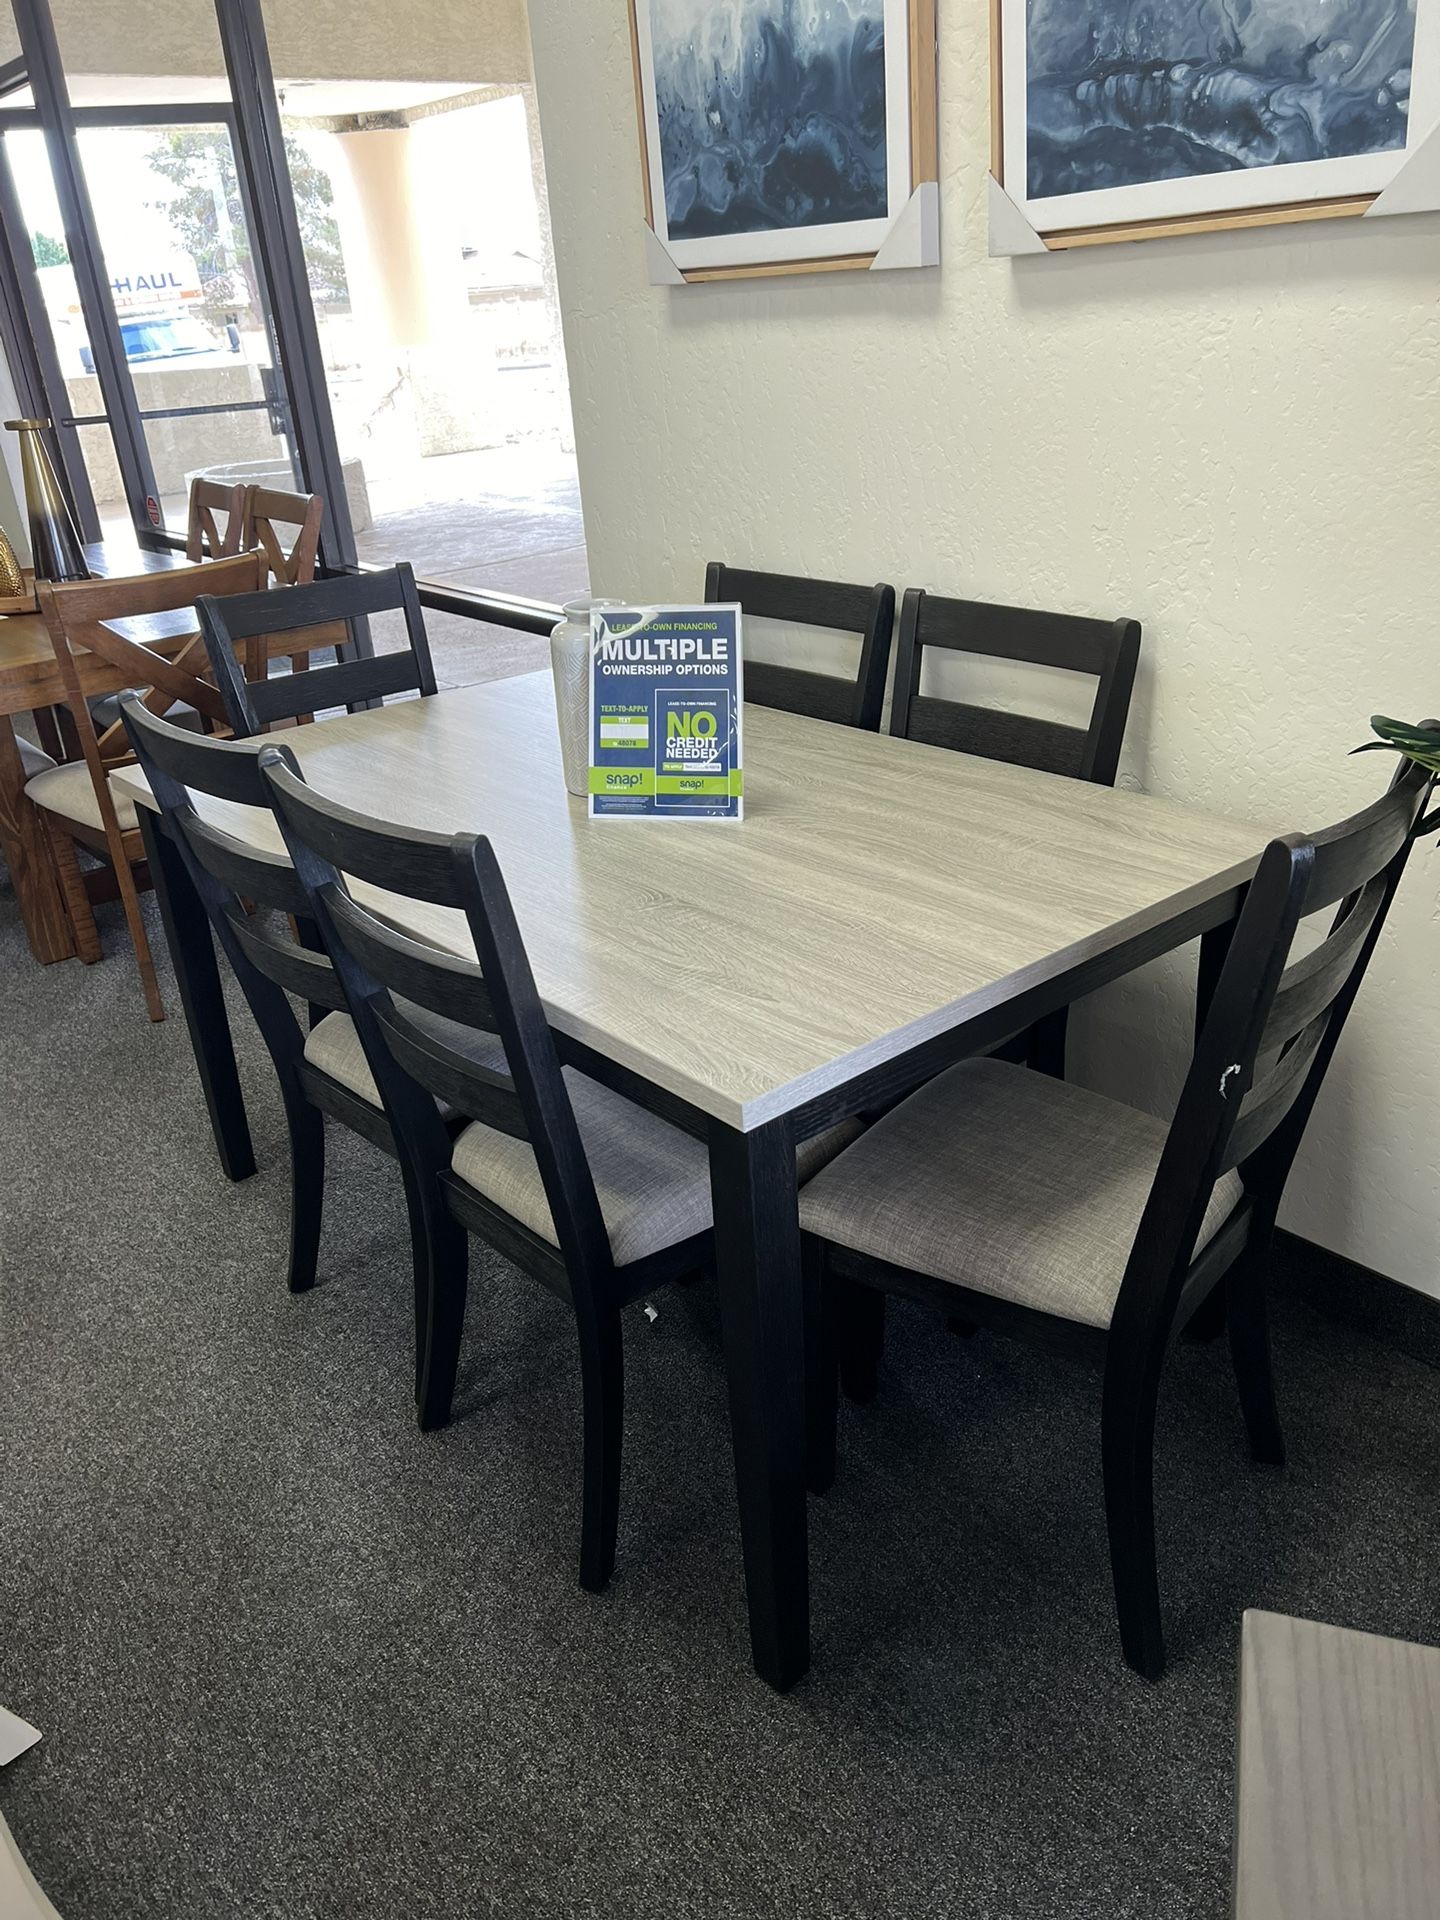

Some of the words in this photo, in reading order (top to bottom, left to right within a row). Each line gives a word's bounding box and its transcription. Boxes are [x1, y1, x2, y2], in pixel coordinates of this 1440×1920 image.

[111, 272, 182, 293] -HAUL
[611, 622, 672, 632] LEASTO-OWN
[673, 622, 718, 630] FINANCING
[602, 638, 728, 661] MULTIPLE
[602, 664, 673, 675] OWNERSHIP
[676, 664, 728, 675] OPTIONS
[601, 704, 649, 713] TEXT-TO-APPLY
[667, 711, 717, 738] NO
[666, 737, 718, 748] CREDIT
[666, 748, 718, 759] NEEDED
[606, 773, 643, 787] snap!
[679, 779, 704, 790] snap!
